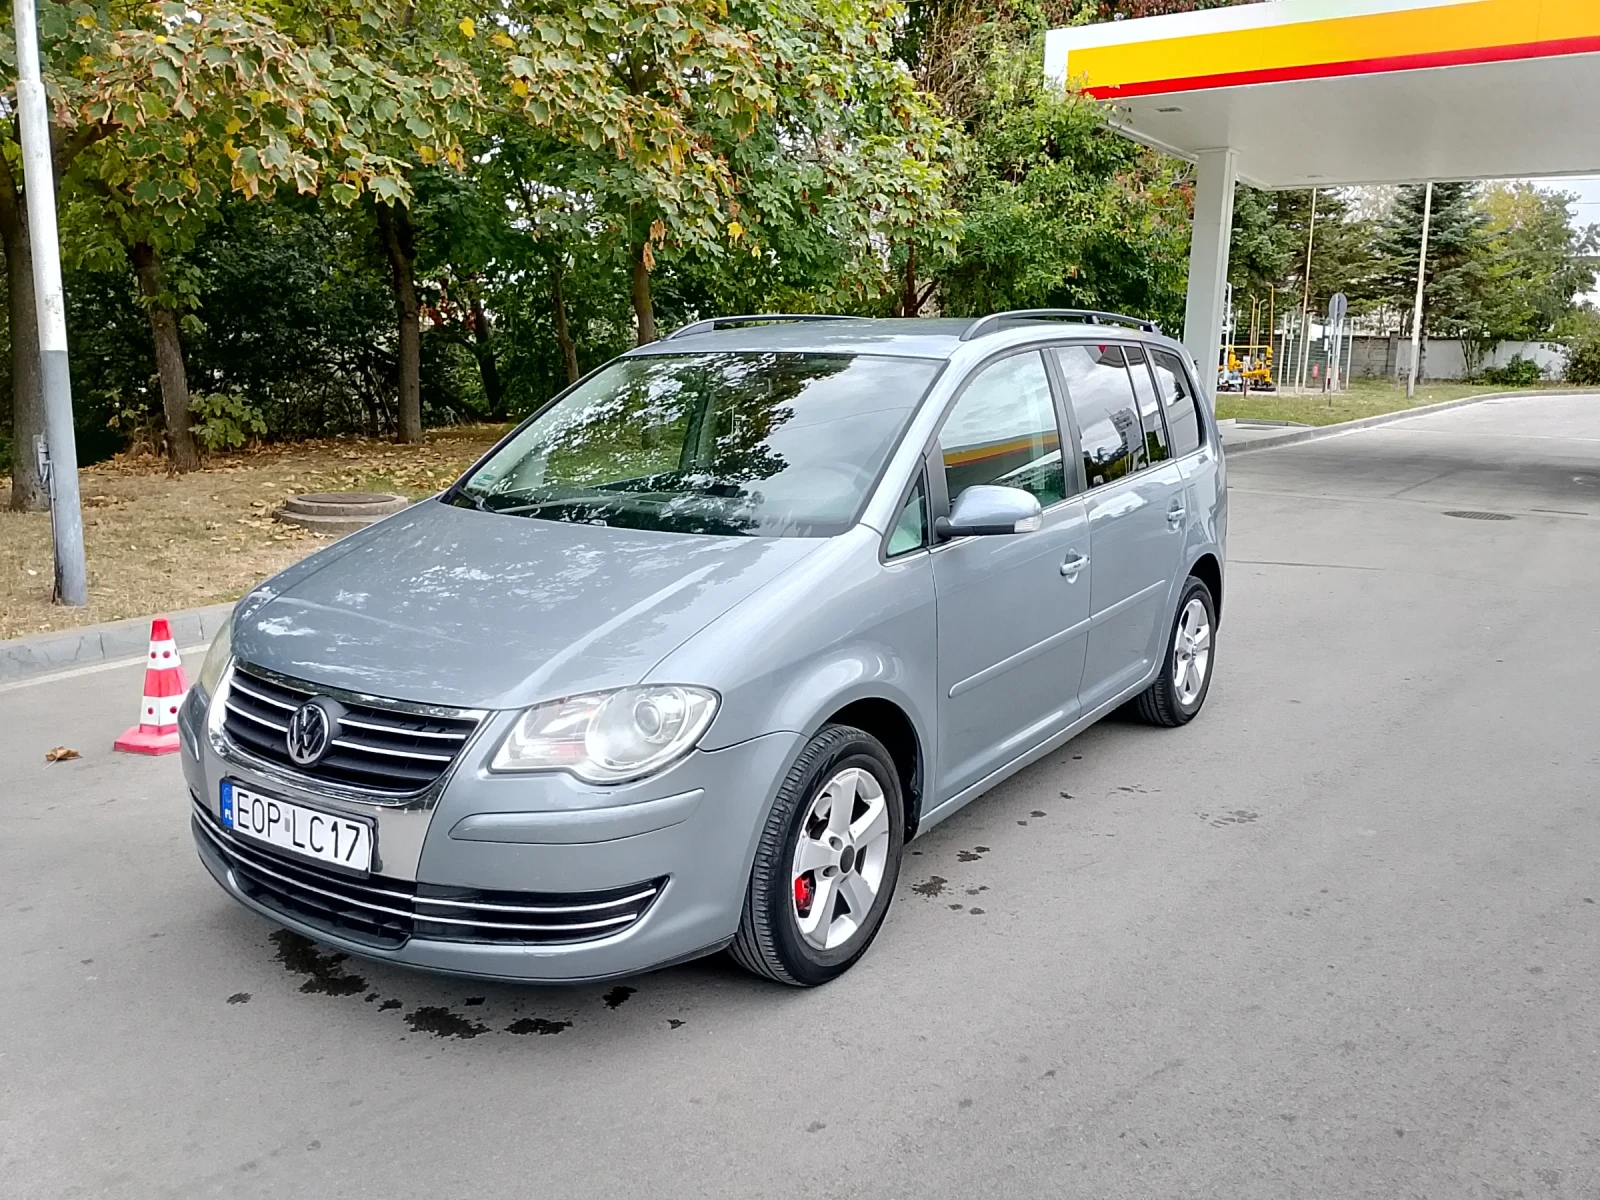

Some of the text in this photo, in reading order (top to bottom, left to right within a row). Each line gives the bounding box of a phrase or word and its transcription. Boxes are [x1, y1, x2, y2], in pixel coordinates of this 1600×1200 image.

[224, 808, 233, 820] PL
[237, 791, 361, 862] EOP LC17
